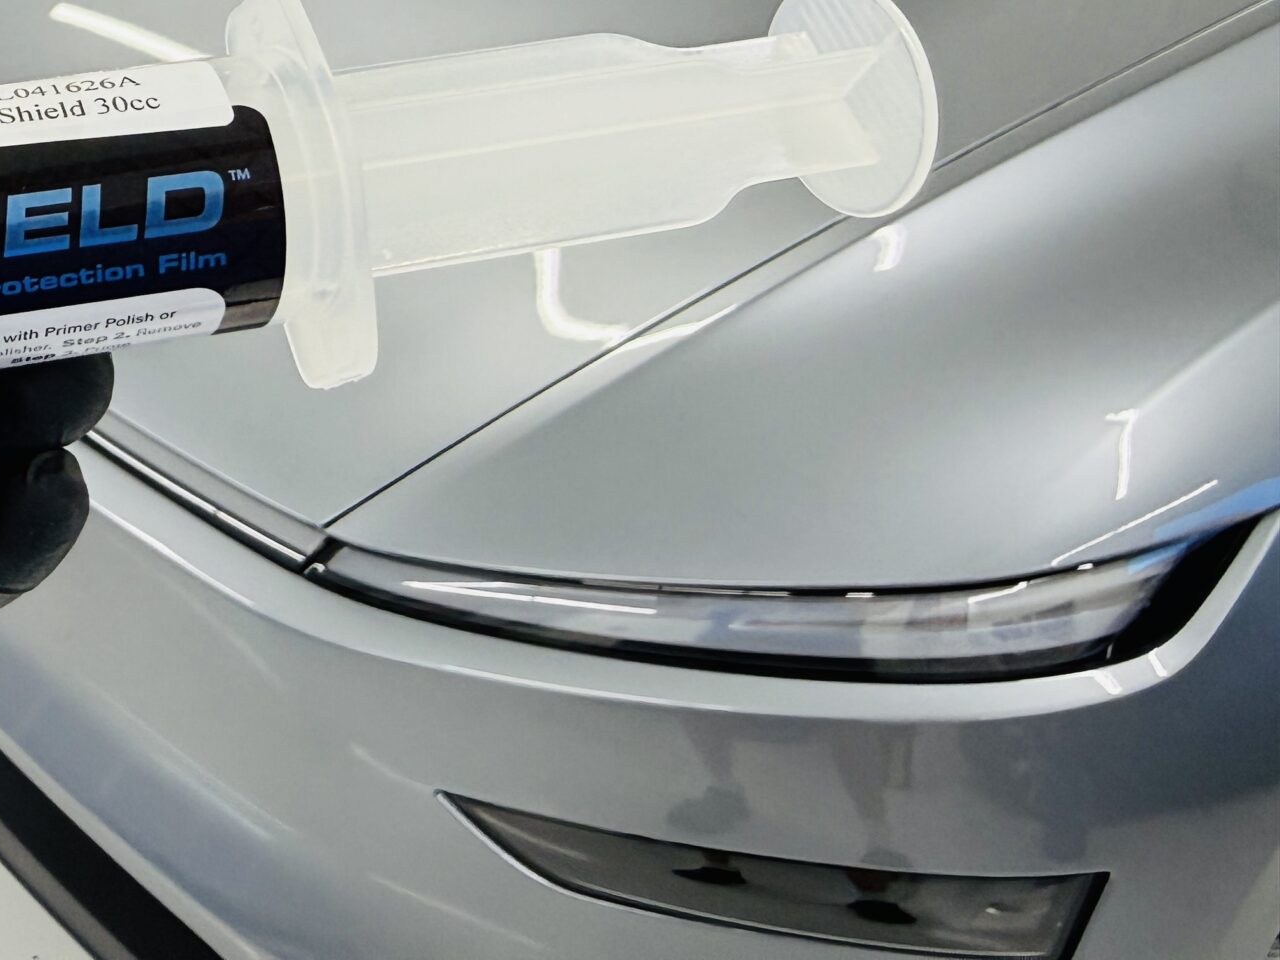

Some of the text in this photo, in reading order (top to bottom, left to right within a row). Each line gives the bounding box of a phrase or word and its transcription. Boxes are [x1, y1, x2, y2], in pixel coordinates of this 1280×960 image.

[94, 96, 161, 115] 30cc
[158, 247, 228, 275] Film
[3, 329, 38, 344] with
[44, 321, 101, 337] Primer
[105, 313, 154, 328] Polish
[159, 310, 178, 320] or
[62, 334, 108, 349] Step
[112, 331, 130, 341] 2.
